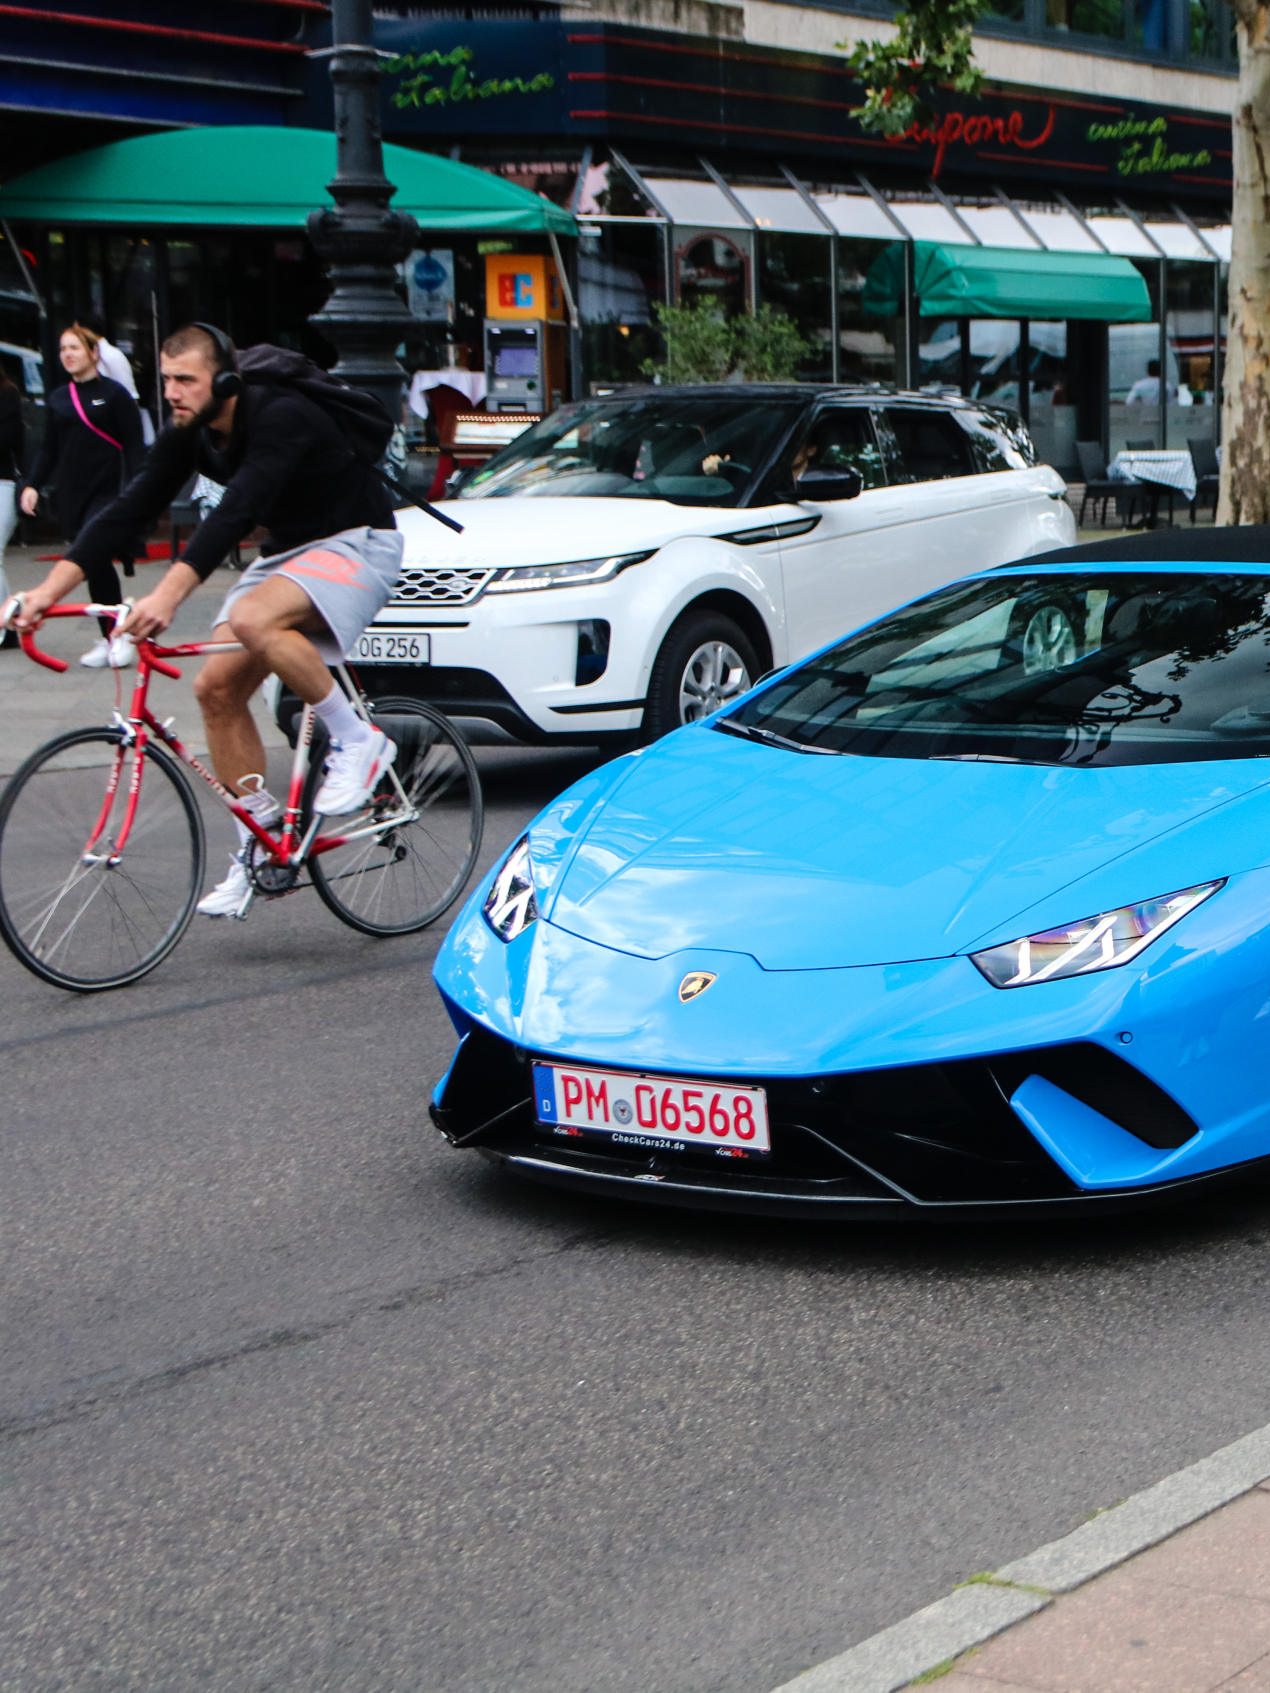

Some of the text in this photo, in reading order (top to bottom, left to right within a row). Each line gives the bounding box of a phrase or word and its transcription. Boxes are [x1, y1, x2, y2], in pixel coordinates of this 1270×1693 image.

[386, 637, 420, 658] 256
[542, 1098, 551, 1113] D
[561, 1073, 756, 1141] PM 06568
[612, 1131, 685, 1151] CheckCars24.de
